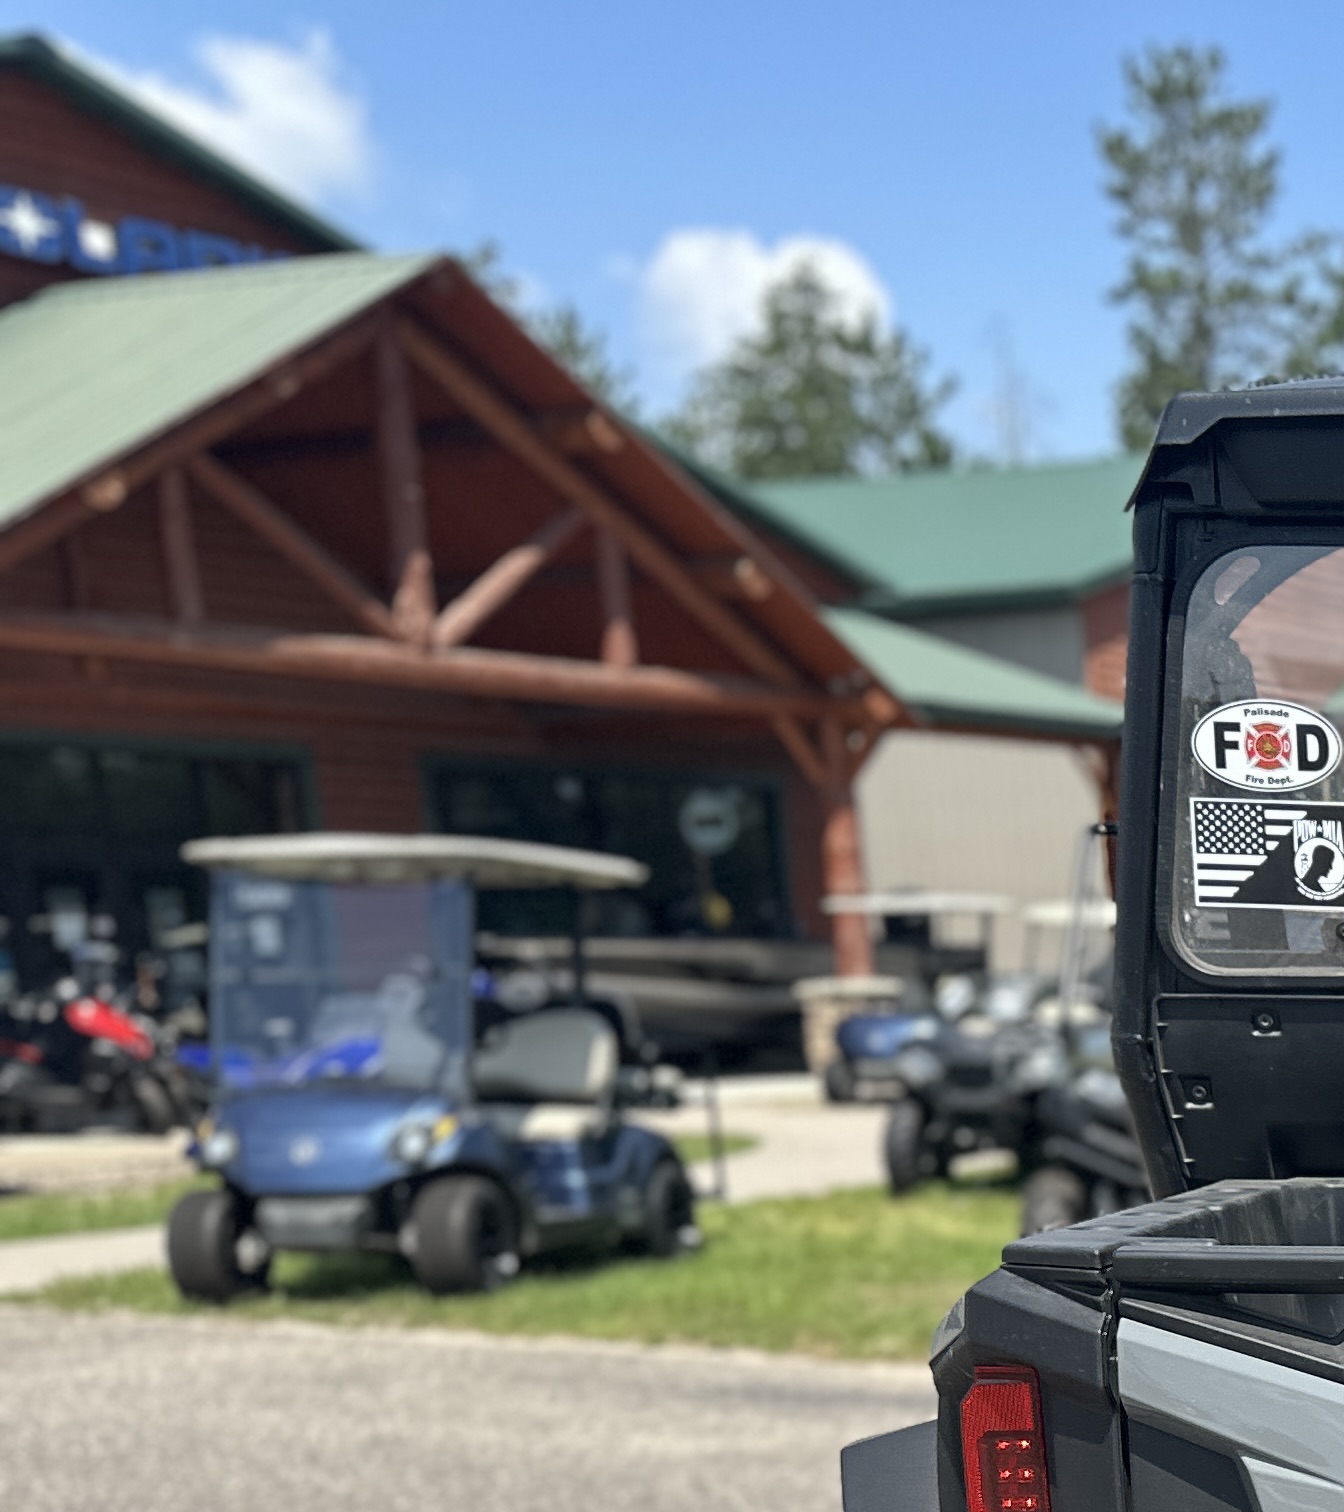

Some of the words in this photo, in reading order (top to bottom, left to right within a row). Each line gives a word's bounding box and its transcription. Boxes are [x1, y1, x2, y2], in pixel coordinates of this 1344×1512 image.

[1244, 708, 1289, 718] Palisade
[1213, 721, 1241, 769] F
[1296, 723, 1330, 772] D
[1245, 774, 1264, 784] Fire
[1267, 776, 1294, 786] Dept.
